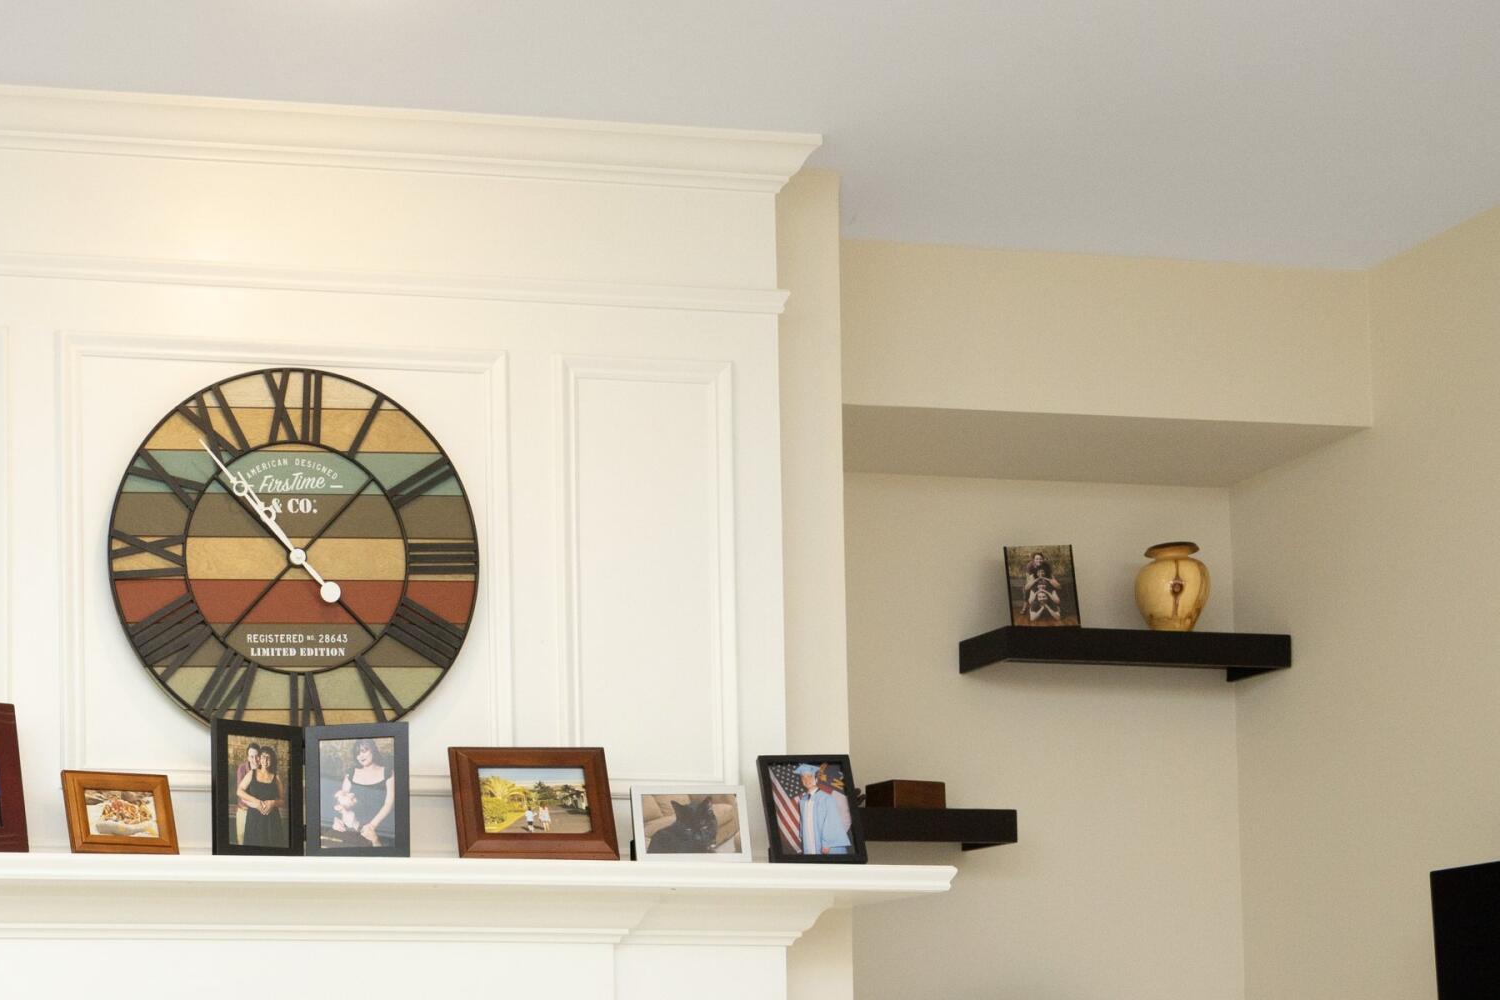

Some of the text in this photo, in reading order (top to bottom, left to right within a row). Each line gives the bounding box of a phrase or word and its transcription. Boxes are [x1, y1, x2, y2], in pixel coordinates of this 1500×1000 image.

[262, 368, 322, 445] XII
[245, 458, 339, 480] AMERICAN DESIGNED
[270, 498, 283, 513] &
[109, 528, 187, 579] IX
[406, 543, 478, 575] III
[246, 633, 305, 643] REGISTERED
[318, 633, 349, 643] 28643
[250, 647, 346, 657] LIMITED EDITION
